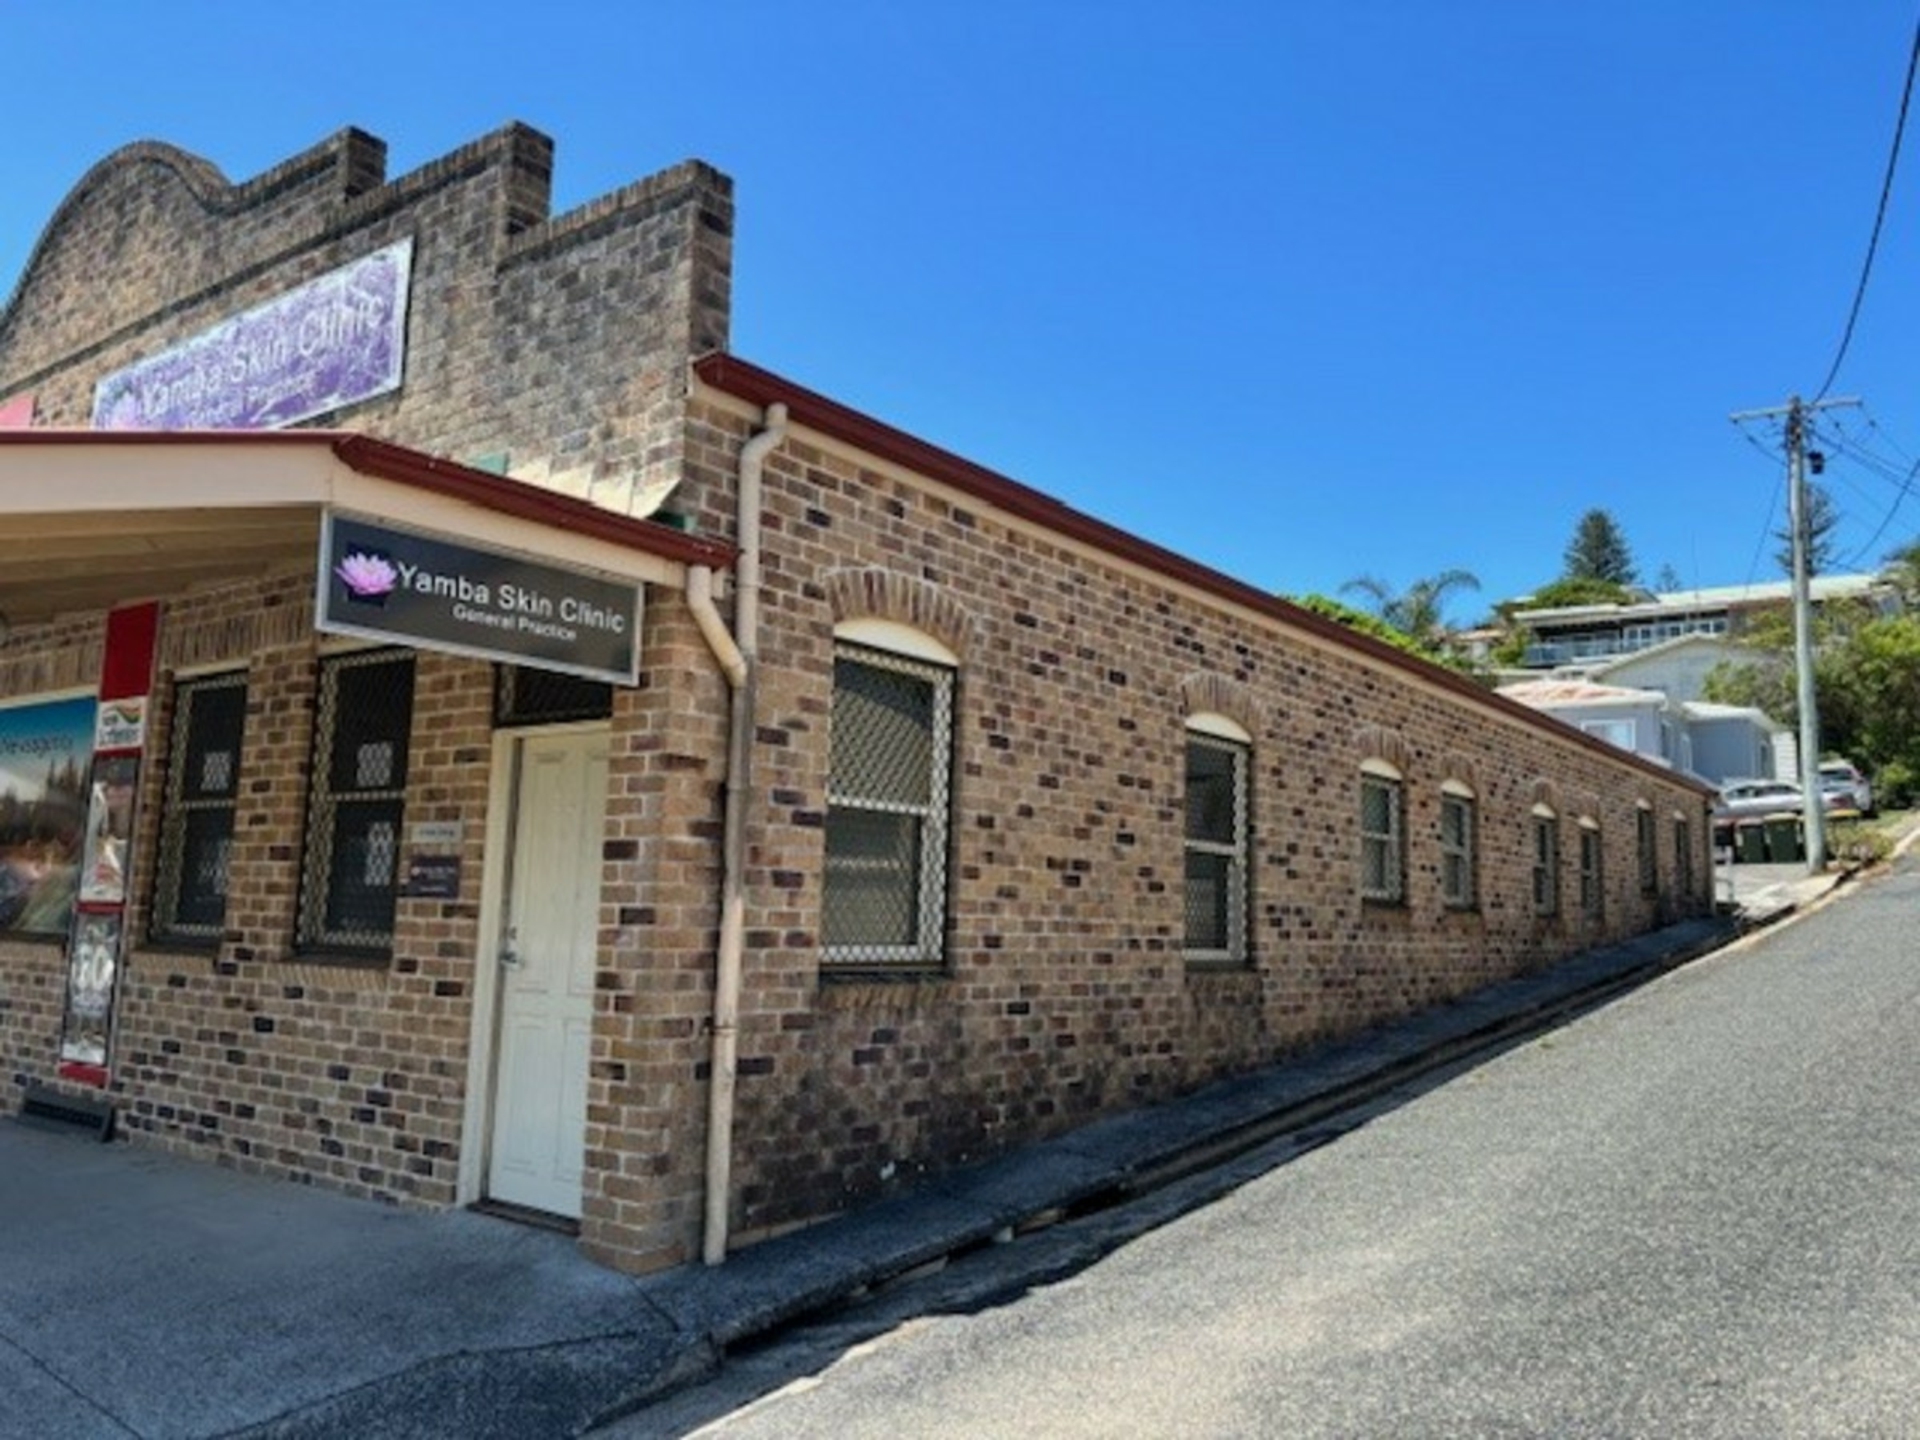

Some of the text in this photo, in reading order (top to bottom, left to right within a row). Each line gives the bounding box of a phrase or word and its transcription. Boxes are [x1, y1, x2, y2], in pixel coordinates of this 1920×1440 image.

[230, 331, 286, 383] Skin
[398, 561, 625, 633] Yamba Skin Clinic
[453, 603, 577, 642] General Practice
